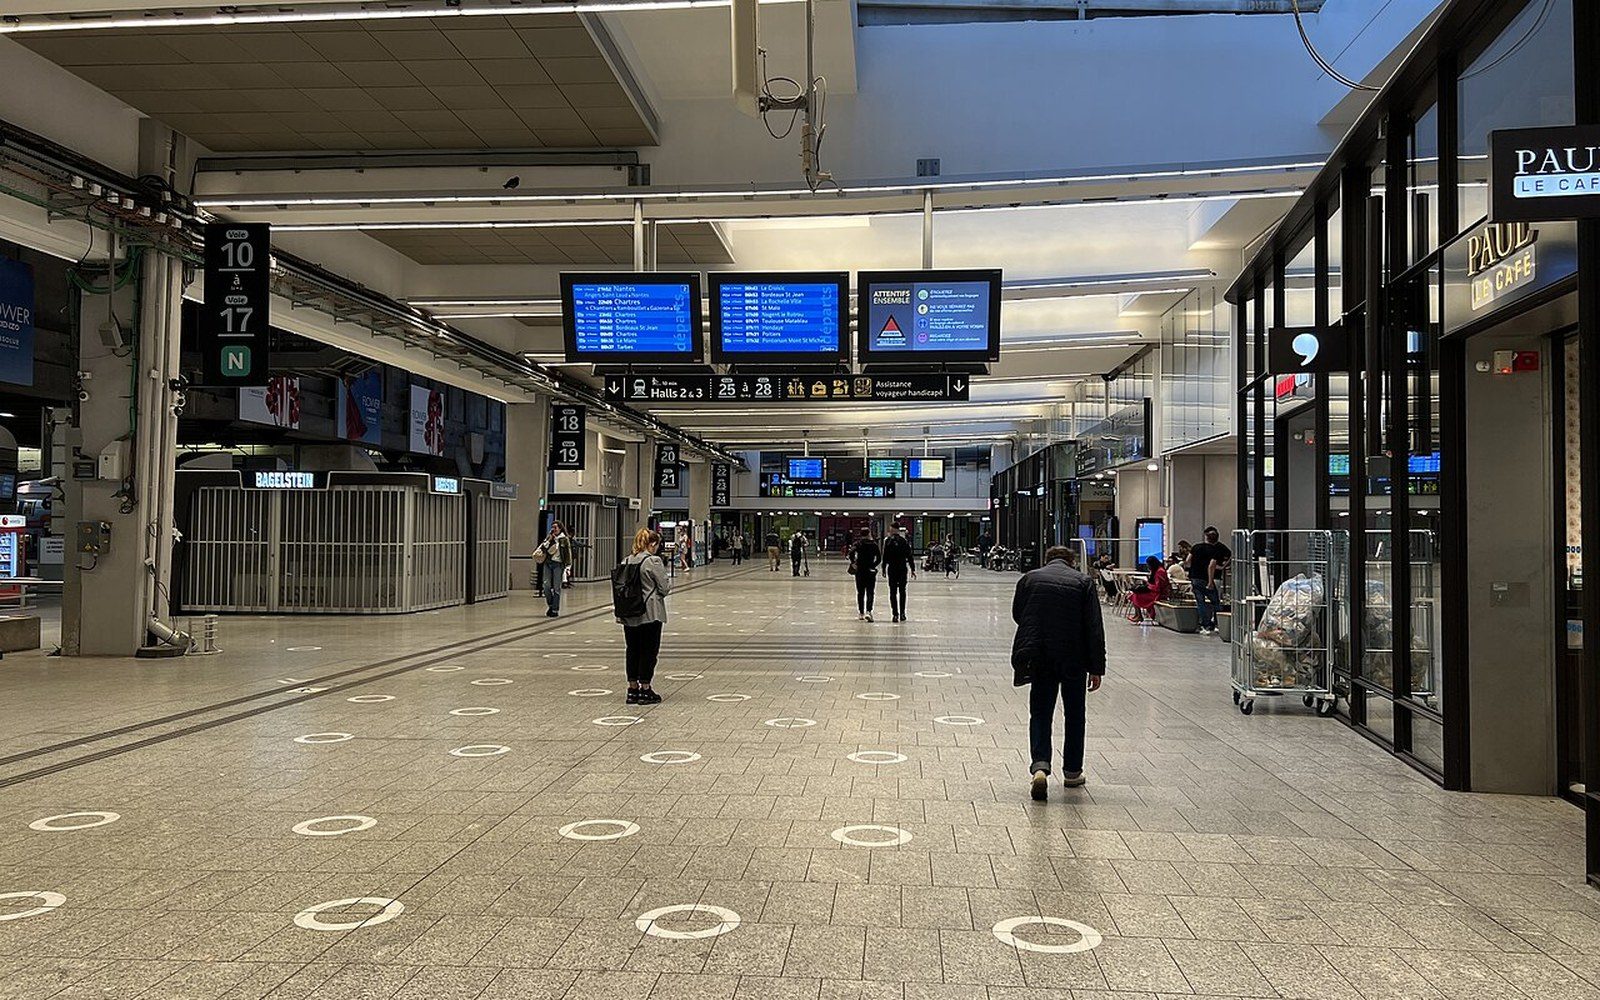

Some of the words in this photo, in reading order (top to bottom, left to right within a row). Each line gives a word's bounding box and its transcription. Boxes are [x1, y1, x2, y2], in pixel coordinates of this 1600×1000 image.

[1515, 146, 1600, 174] PAU
[1522, 180, 1544, 192] LE
[1559, 178, 1599, 190] CAF
[228, 230, 246, 238] Voie
[220, 242, 254, 267] 10
[1468, 222, 1531, 276] PAUL
[233, 274, 240, 286] à
[1475, 278, 1488, 304] LE
[1496, 251, 1530, 290] CAFÉ
[0, 303, 30, 324] WER
[220, 308, 253, 332] 17
[228, 352, 243, 370] N
[651, 388, 678, 398] Halls
[680, 388, 686, 398] 2
[696, 388, 703, 398] 3
[719, 383, 736, 395] 25
[742, 382, 748, 392] à
[755, 383, 772, 395] 28
[908, 389, 943, 397] handicapé
[560, 416, 579, 430] 18
[560, 448, 578, 462] 19
[661, 451, 675, 461] 20
[256, 472, 314, 488] BAGELSTEIN
[662, 474, 675, 485] 21
